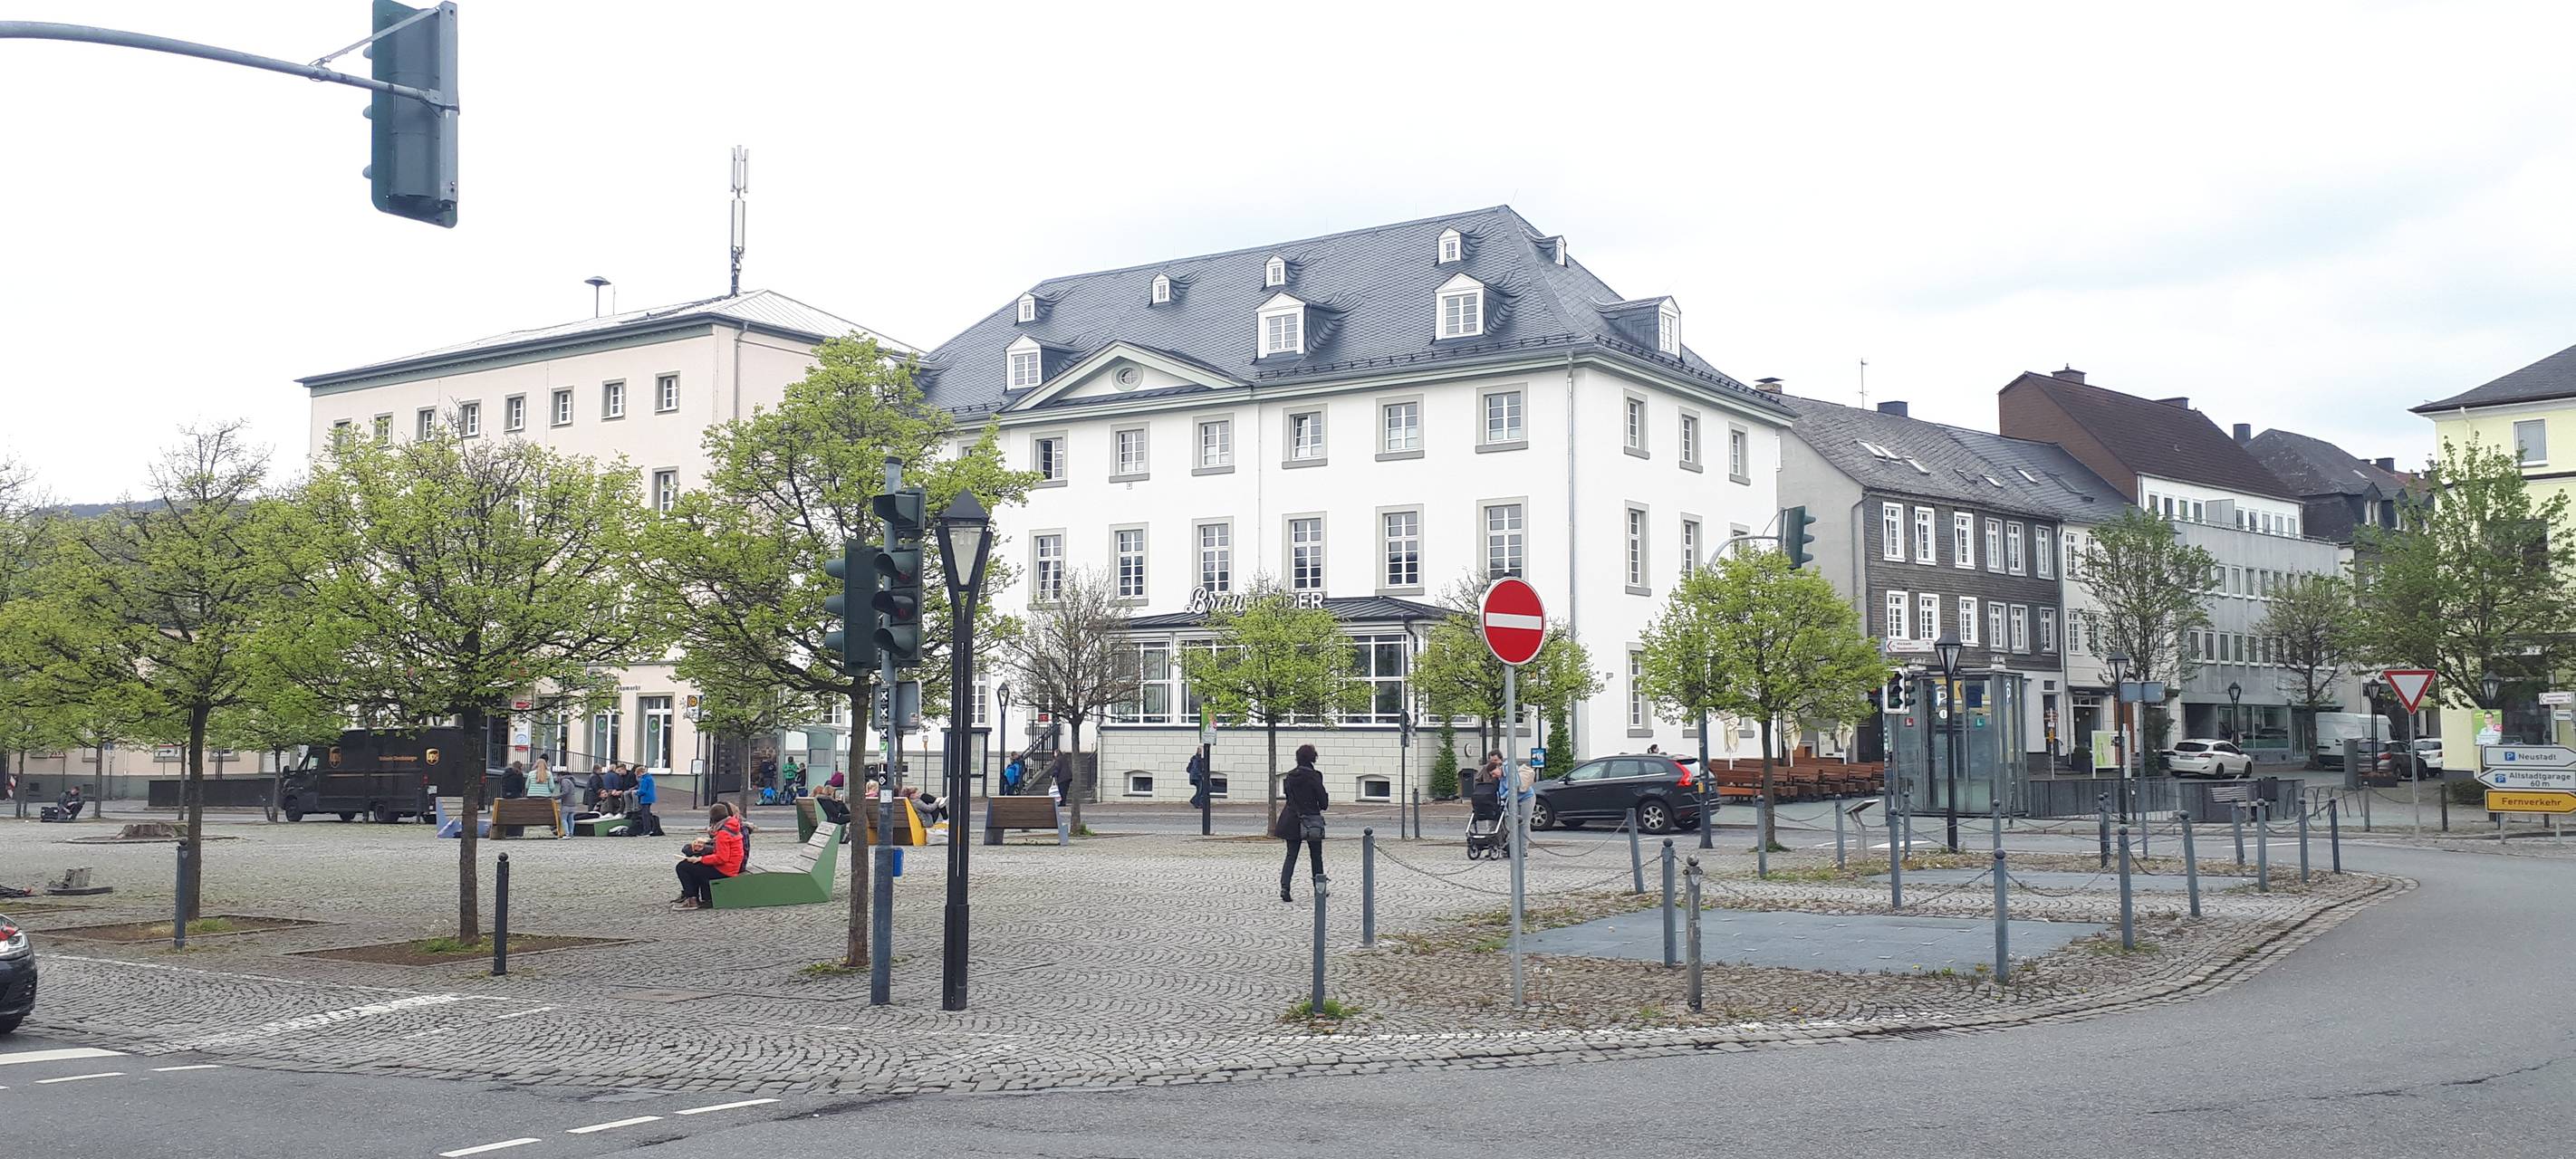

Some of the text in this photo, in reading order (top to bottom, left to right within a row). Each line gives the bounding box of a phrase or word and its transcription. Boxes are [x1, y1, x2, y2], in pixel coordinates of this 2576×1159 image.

[1184, 586, 1324, 614] BrauDER
[2509, 772, 2571, 781] Altstadtgarage
[2502, 797, 2562, 806] Fernverkehr
